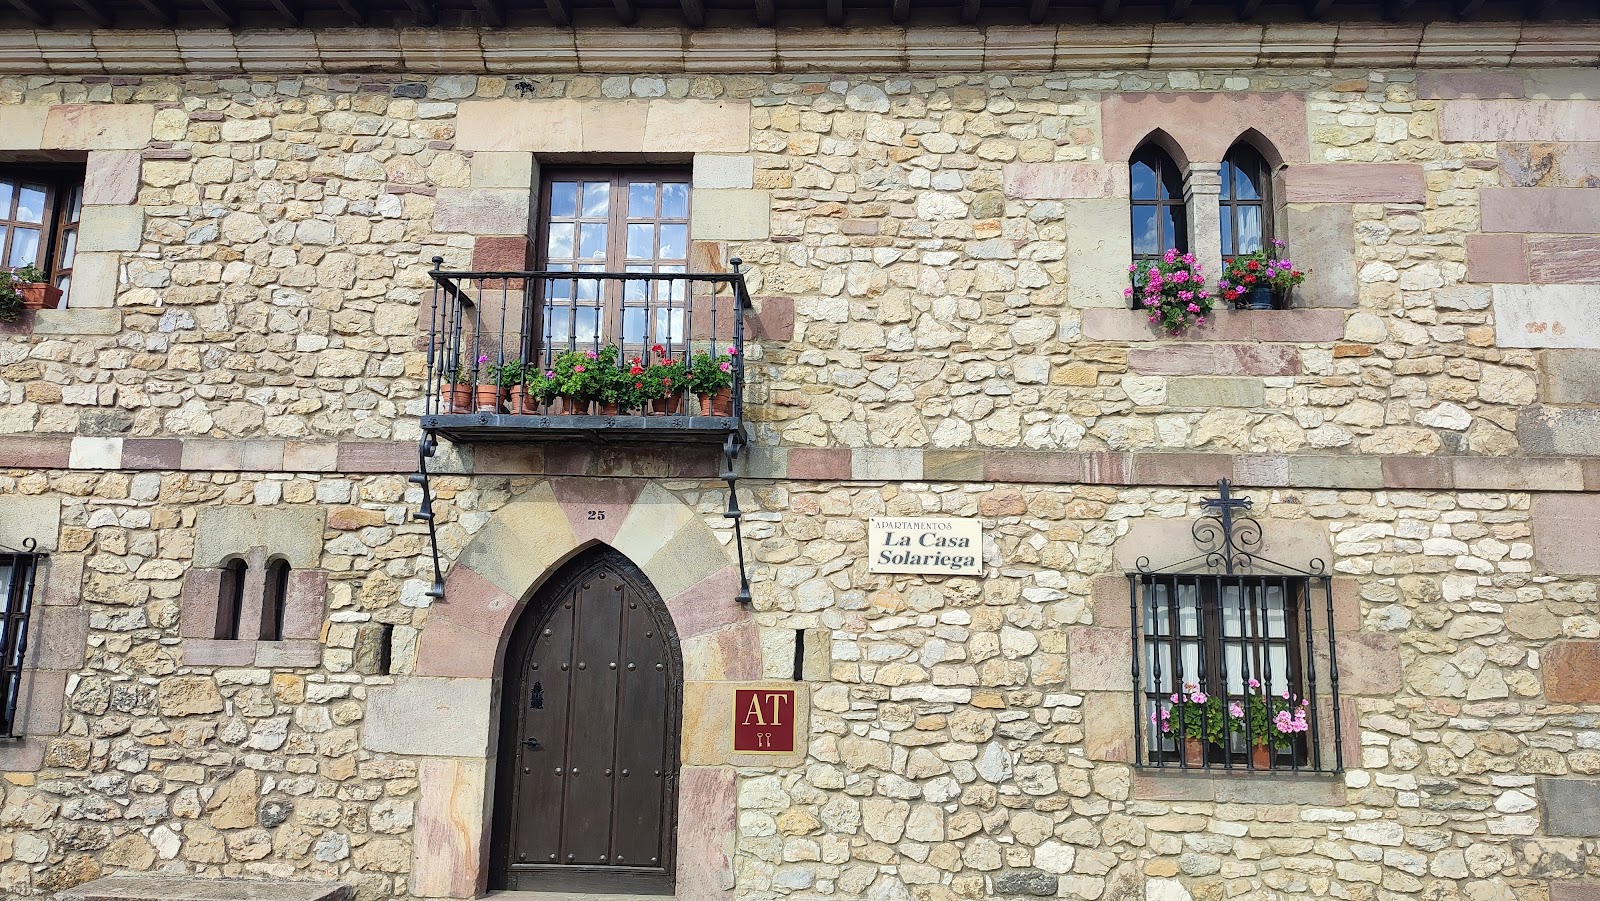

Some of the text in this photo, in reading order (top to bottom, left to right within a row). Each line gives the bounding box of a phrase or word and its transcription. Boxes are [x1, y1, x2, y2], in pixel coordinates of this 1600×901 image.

[587, 510, 606, 521] 25
[875, 521, 953, 531] APARTAMENTOS
[883, 531, 970, 548] La Casa
[878, 550, 975, 571] Solariega
[741, 693, 788, 726] AT
